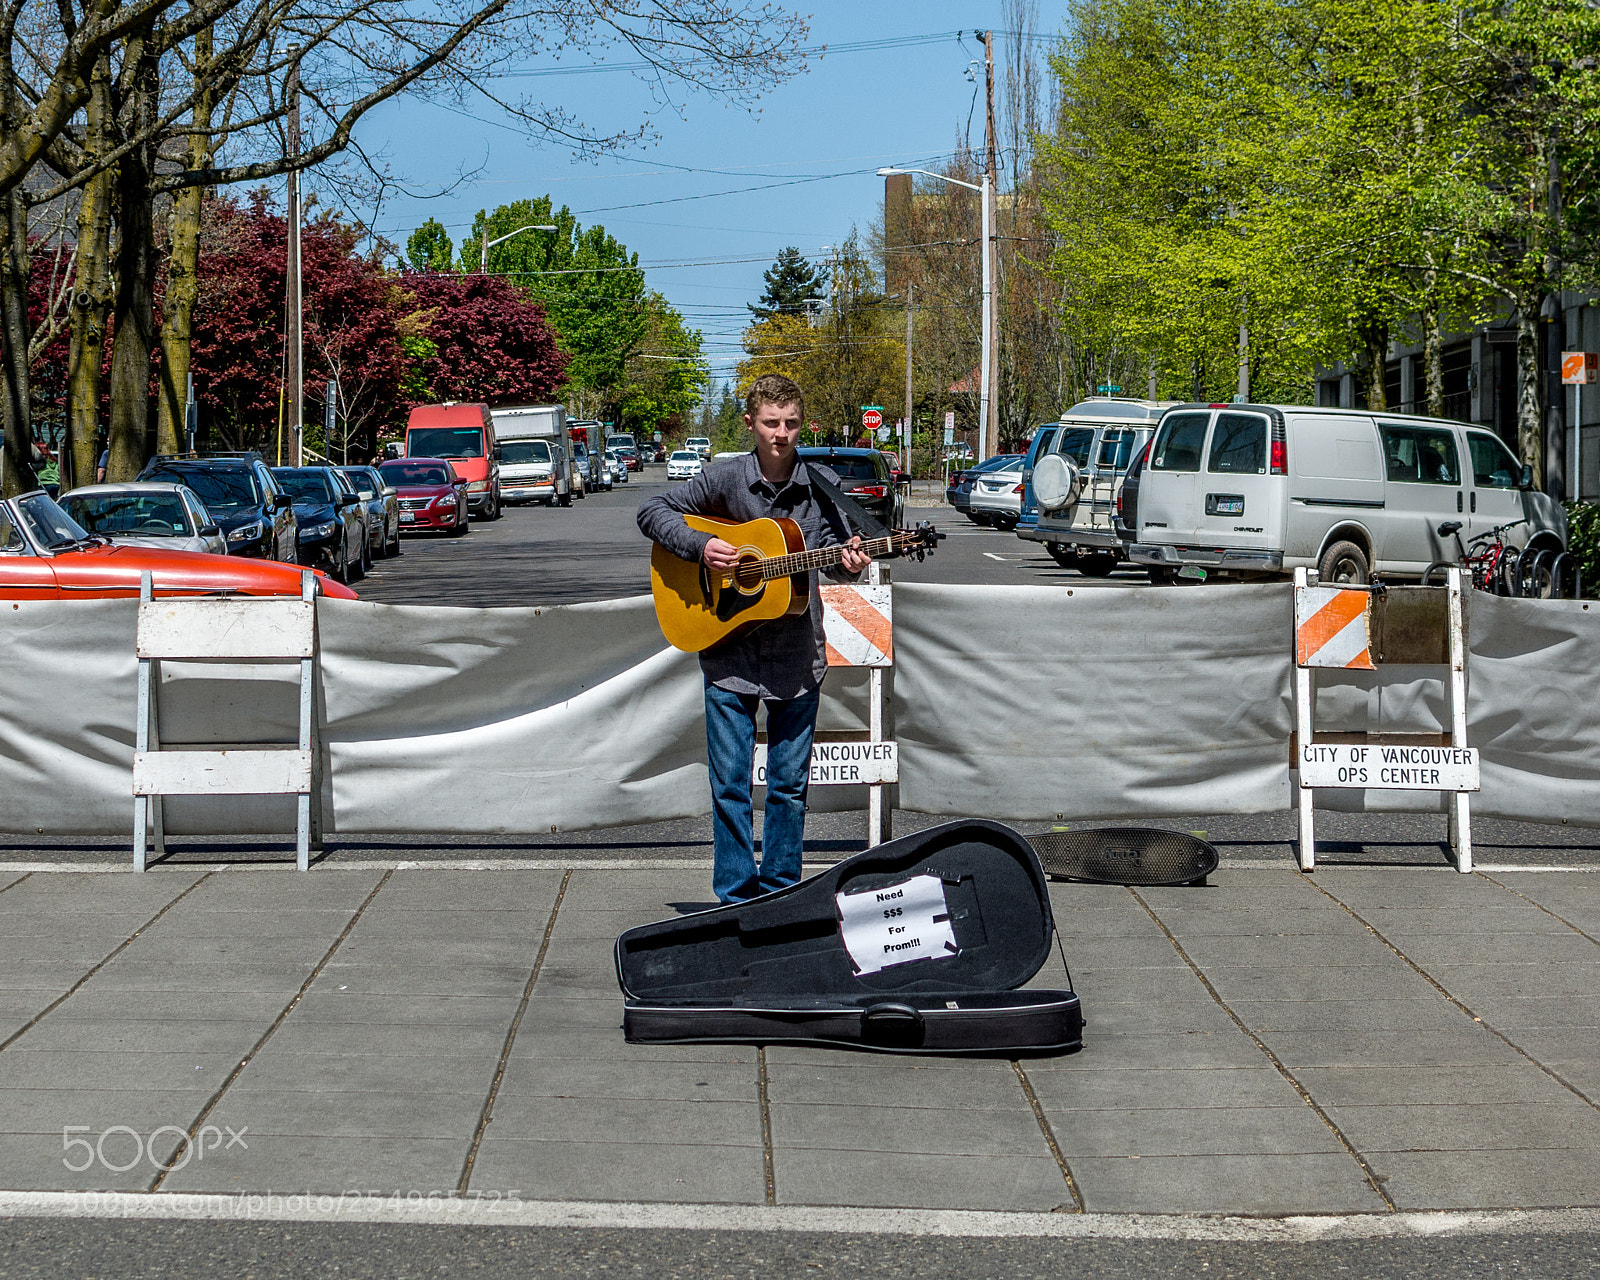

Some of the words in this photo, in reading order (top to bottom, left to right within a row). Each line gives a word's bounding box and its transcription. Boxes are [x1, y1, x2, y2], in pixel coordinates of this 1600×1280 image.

[1588, 354, 1594, 366] 3
[864, 416, 881, 424] STOP
[811, 745, 893, 762] ANCOUVER
[1303, 747, 1338, 763] CITY
[1350, 747, 1370, 763] OF
[1381, 748, 1473, 765] VANCOUVER
[810, 765, 860, 781] ENTER
[1338, 767, 1368, 783] OPS
[1380, 768, 1441, 784] CENTER
[876, 889, 904, 903] Need
[883, 907, 903, 919] $$$
[888, 926, 906, 935] For
[884, 938, 921, 953] Prom!!!
